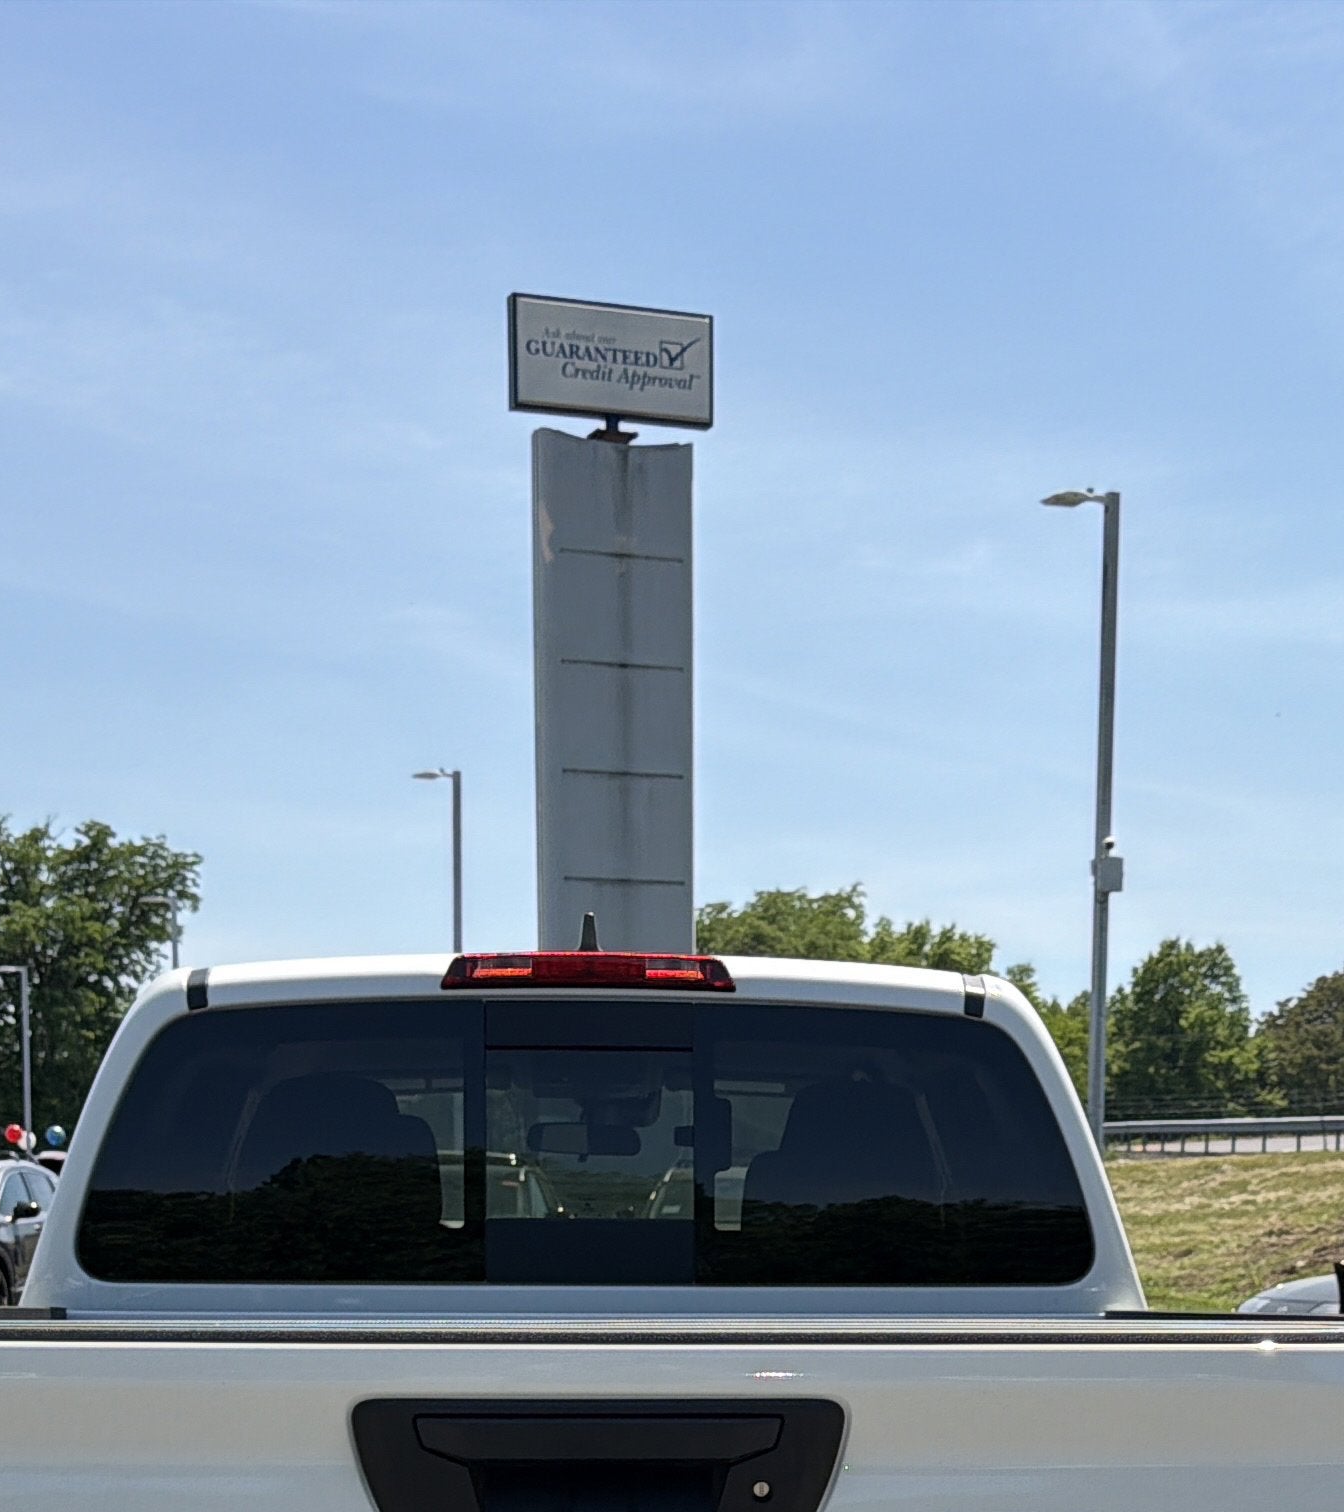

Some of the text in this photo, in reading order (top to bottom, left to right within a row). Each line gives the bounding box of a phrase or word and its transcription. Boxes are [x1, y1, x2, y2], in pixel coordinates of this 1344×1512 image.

[525, 338, 658, 368] GUARANTEED
[561, 360, 694, 392] Credit Approval
